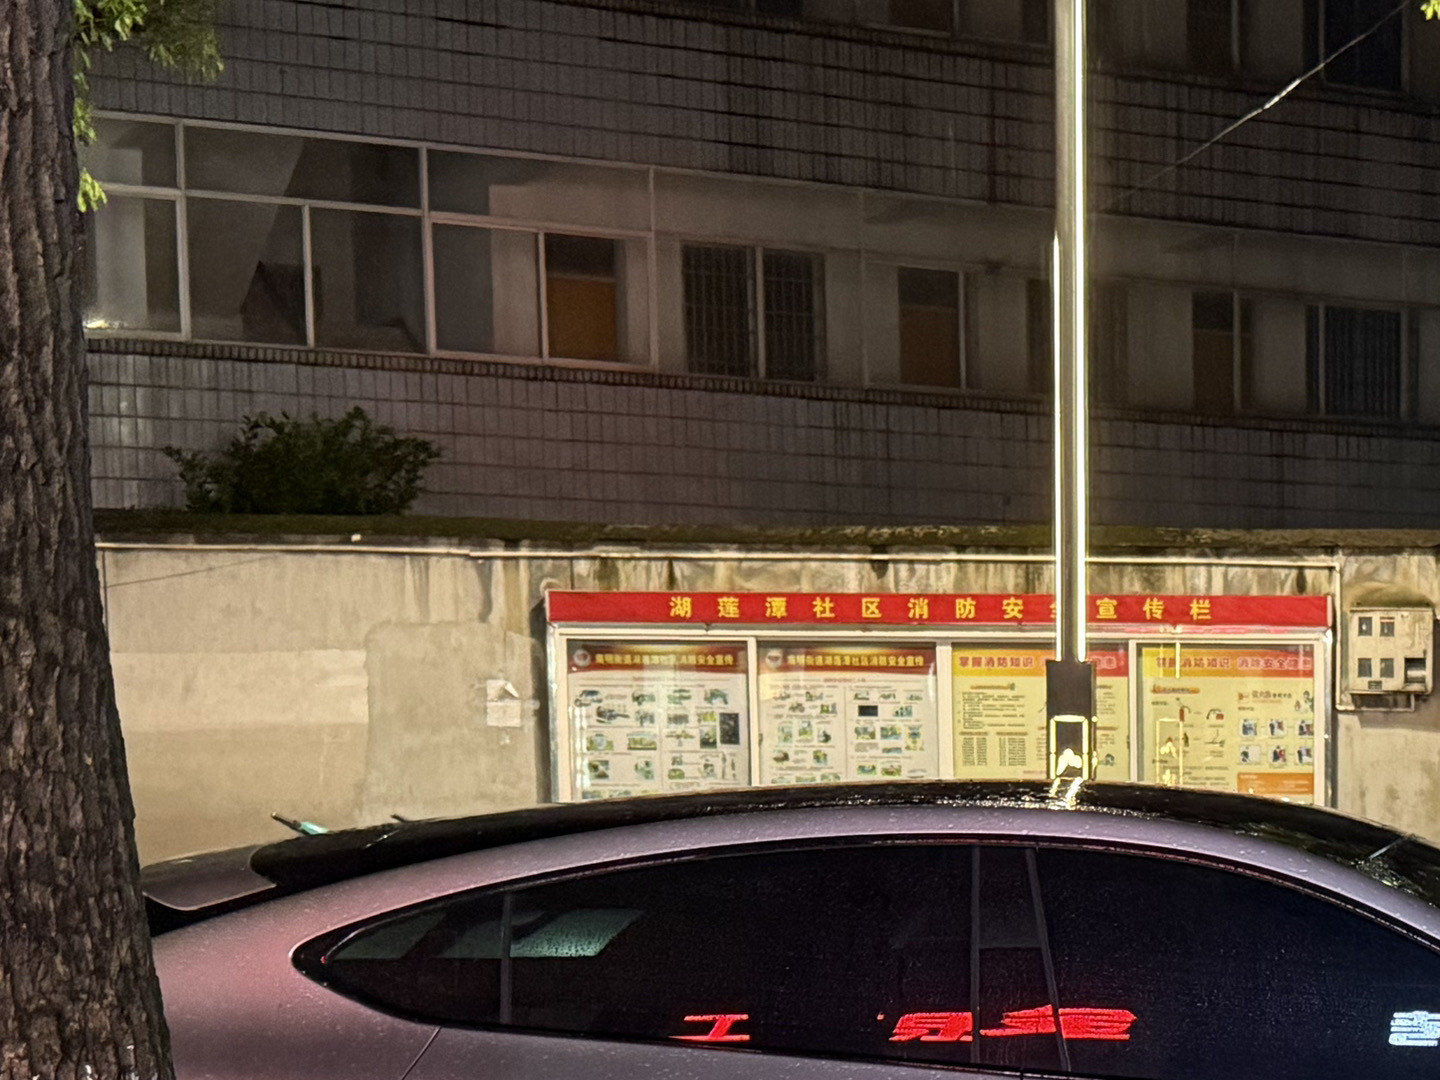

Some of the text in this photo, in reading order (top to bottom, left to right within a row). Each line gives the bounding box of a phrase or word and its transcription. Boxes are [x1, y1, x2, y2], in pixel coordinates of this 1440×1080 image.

[669, 596, 1212, 621] 湖莲潭社区消防安宣传栏
